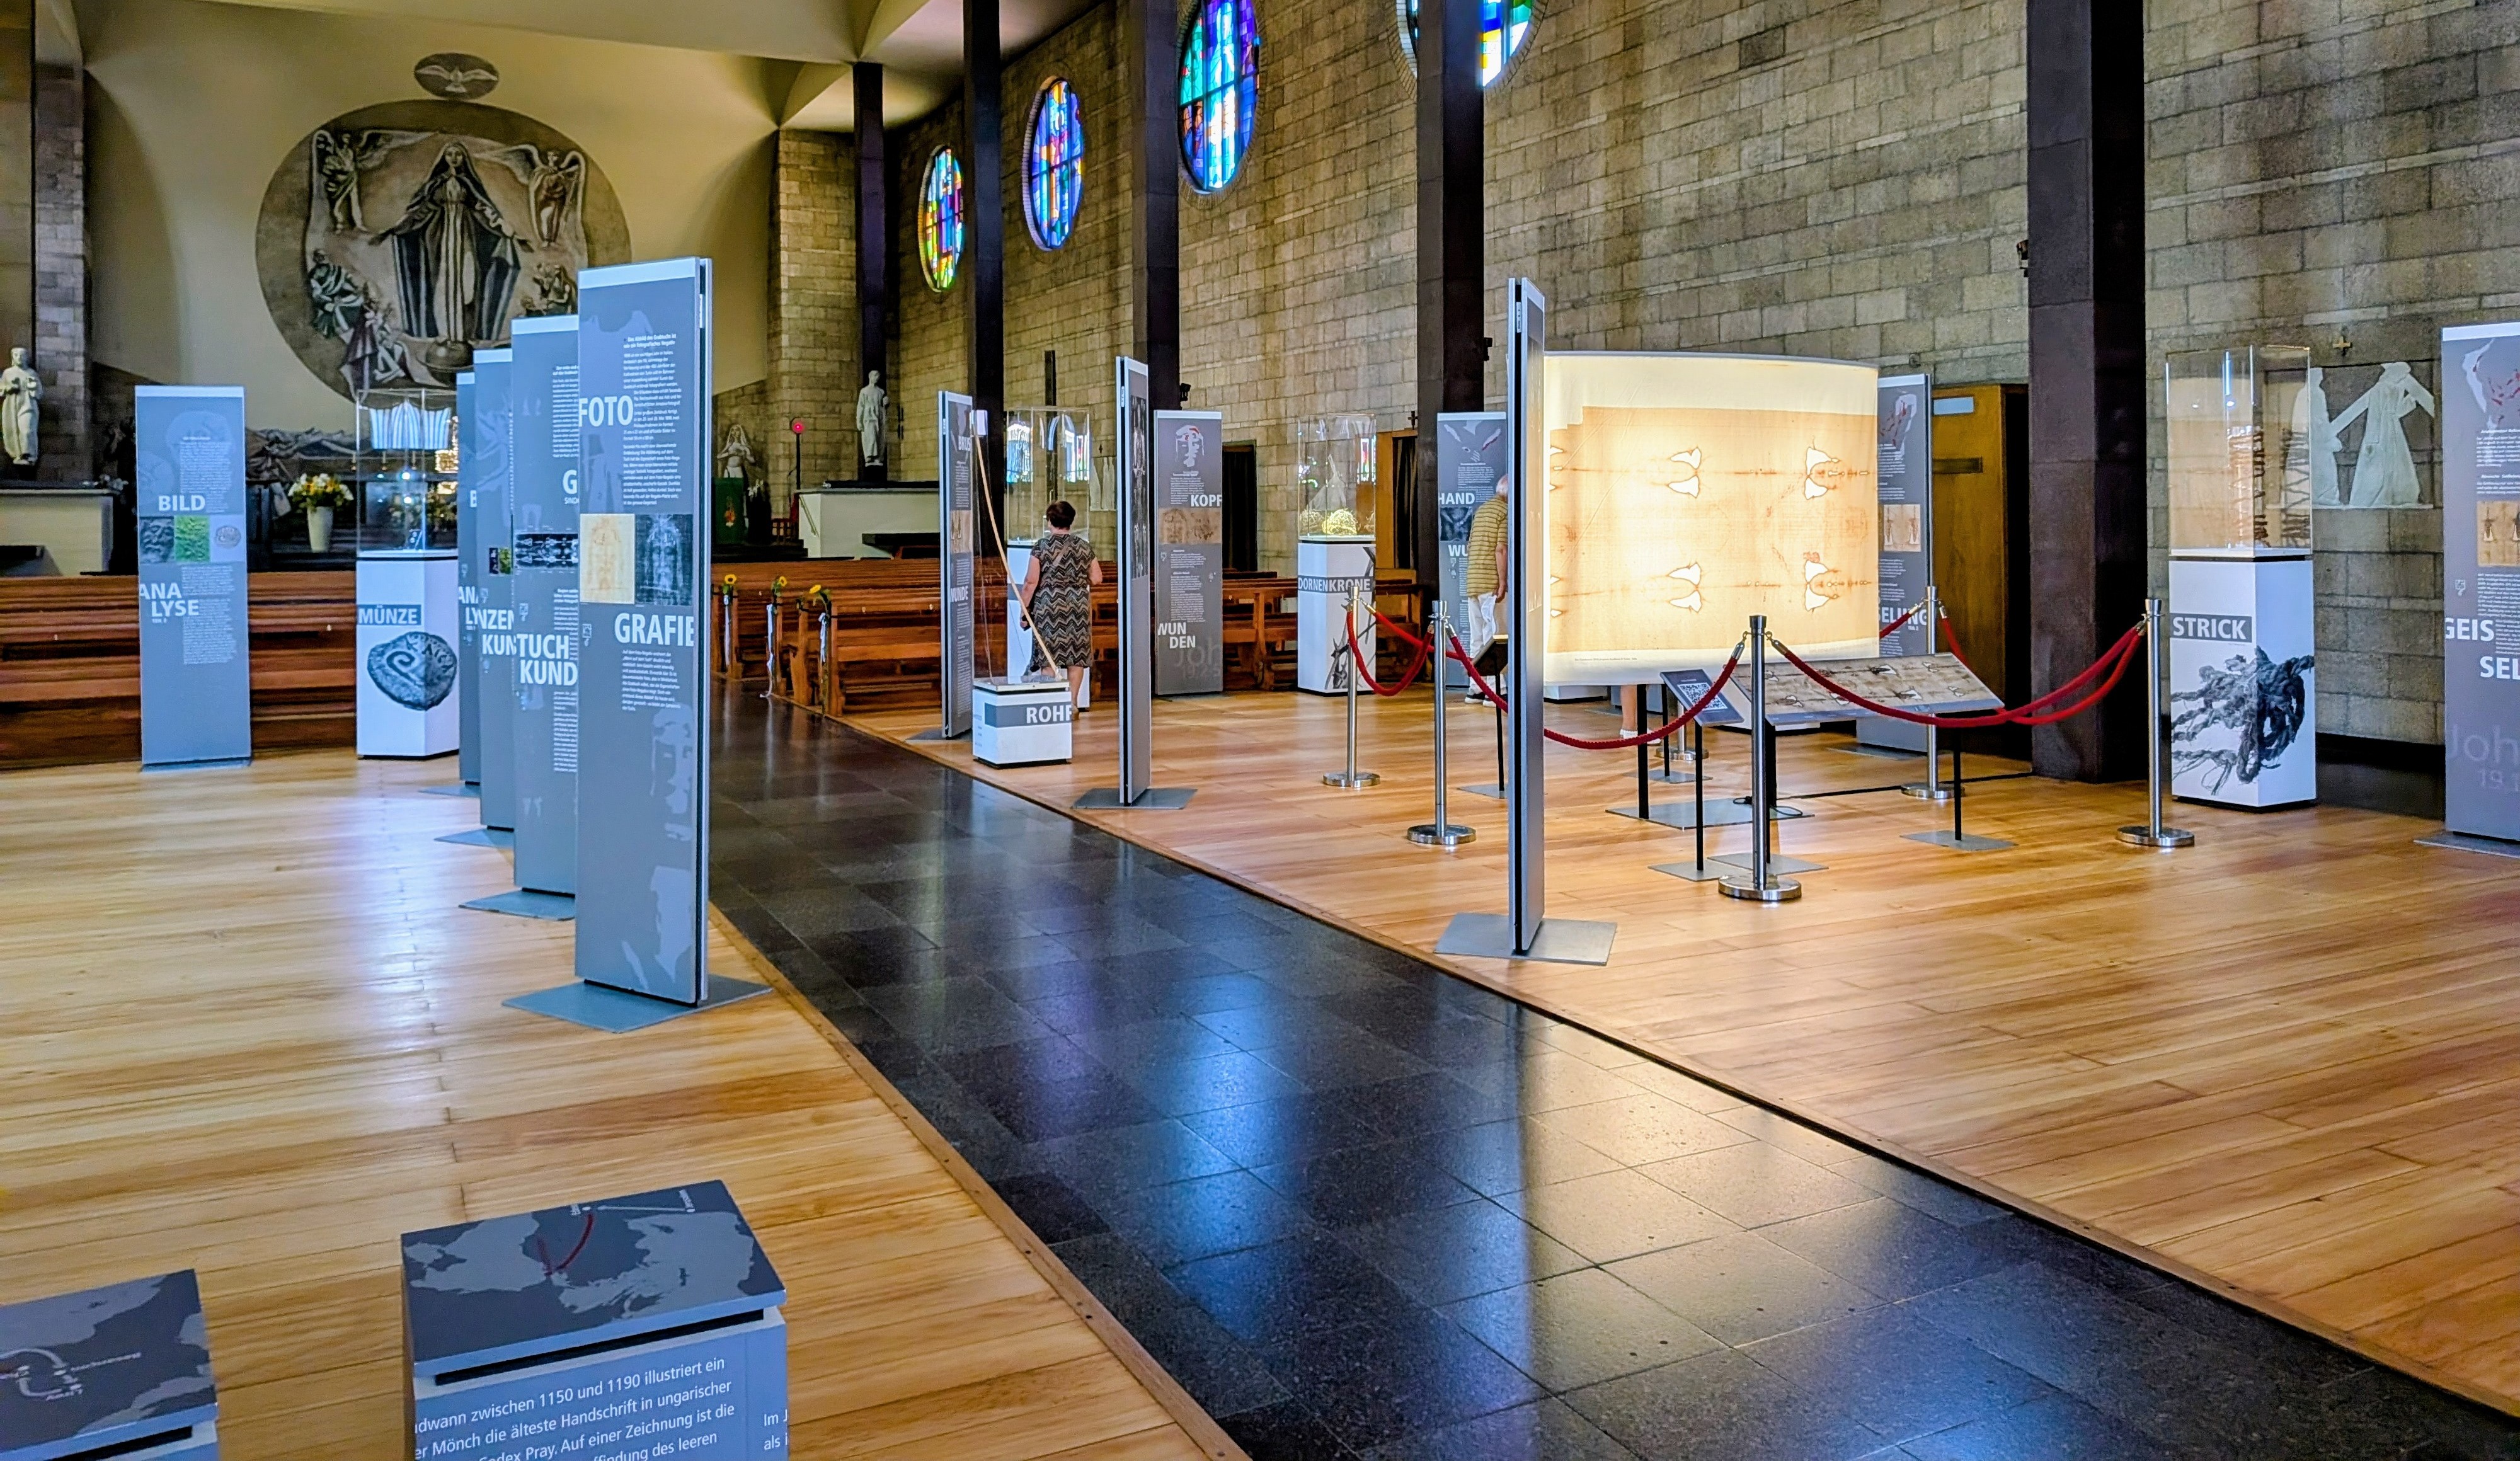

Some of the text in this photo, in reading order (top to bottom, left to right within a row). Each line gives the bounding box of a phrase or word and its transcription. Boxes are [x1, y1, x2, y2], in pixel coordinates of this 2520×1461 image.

[579, 396, 634, 427] FOTO
[159, 495, 205, 511] BILD
[1191, 494, 1222, 507] KOPF
[1439, 493, 1475, 505] HAND
[139, 582, 182, 600] ANA
[458, 586, 479, 604] AN
[151, 599, 199, 617] LYSE
[358, 605, 418, 624] MÜNZE
[615, 612, 694, 646] GRAFIE
[1157, 622, 1186, 636] WUN
[2172, 616, 2247, 639] STRICK
[2445, 617, 2495, 641] GEIS
[513, 633, 569, 660] TUCH
[1169, 635, 1196, 649] DEN
[520, 660, 578, 686] KUND
[2480, 656, 2520, 680] SEL
[471, 1399, 534, 1422] zwischen
[539, 1388, 573, 1407] 1150
[578, 1382, 603, 1399] und
[607, 1374, 640, 1392] 1190
[644, 1361, 701, 1385] illustriert
[706, 1357, 724, 1372] ein
[433, 1433, 481, 1455] Mönch
[485, 1429, 507, 1444] die
[511, 1419, 556, 1438] älteste
[561, 1399, 638, 1428] Handschrift
[641, 1397, 653, 1411] in
[657, 1381, 731, 1407] ungarischer
[764, 1414, 779, 1426] Im
[525, 1443, 558, 1460] Pray.
[560, 1434, 585, 1453] Auf
[588, 1429, 622, 1447] einer
[626, 1412, 692, 1439] Zeichnung
[696, 1408, 712, 1423] ist
[715, 1404, 735, 1418] die
[764, 1435, 781, 1450] als
[652, 1442, 675, 1457] des
[679, 1433, 718, 1450] leeren
